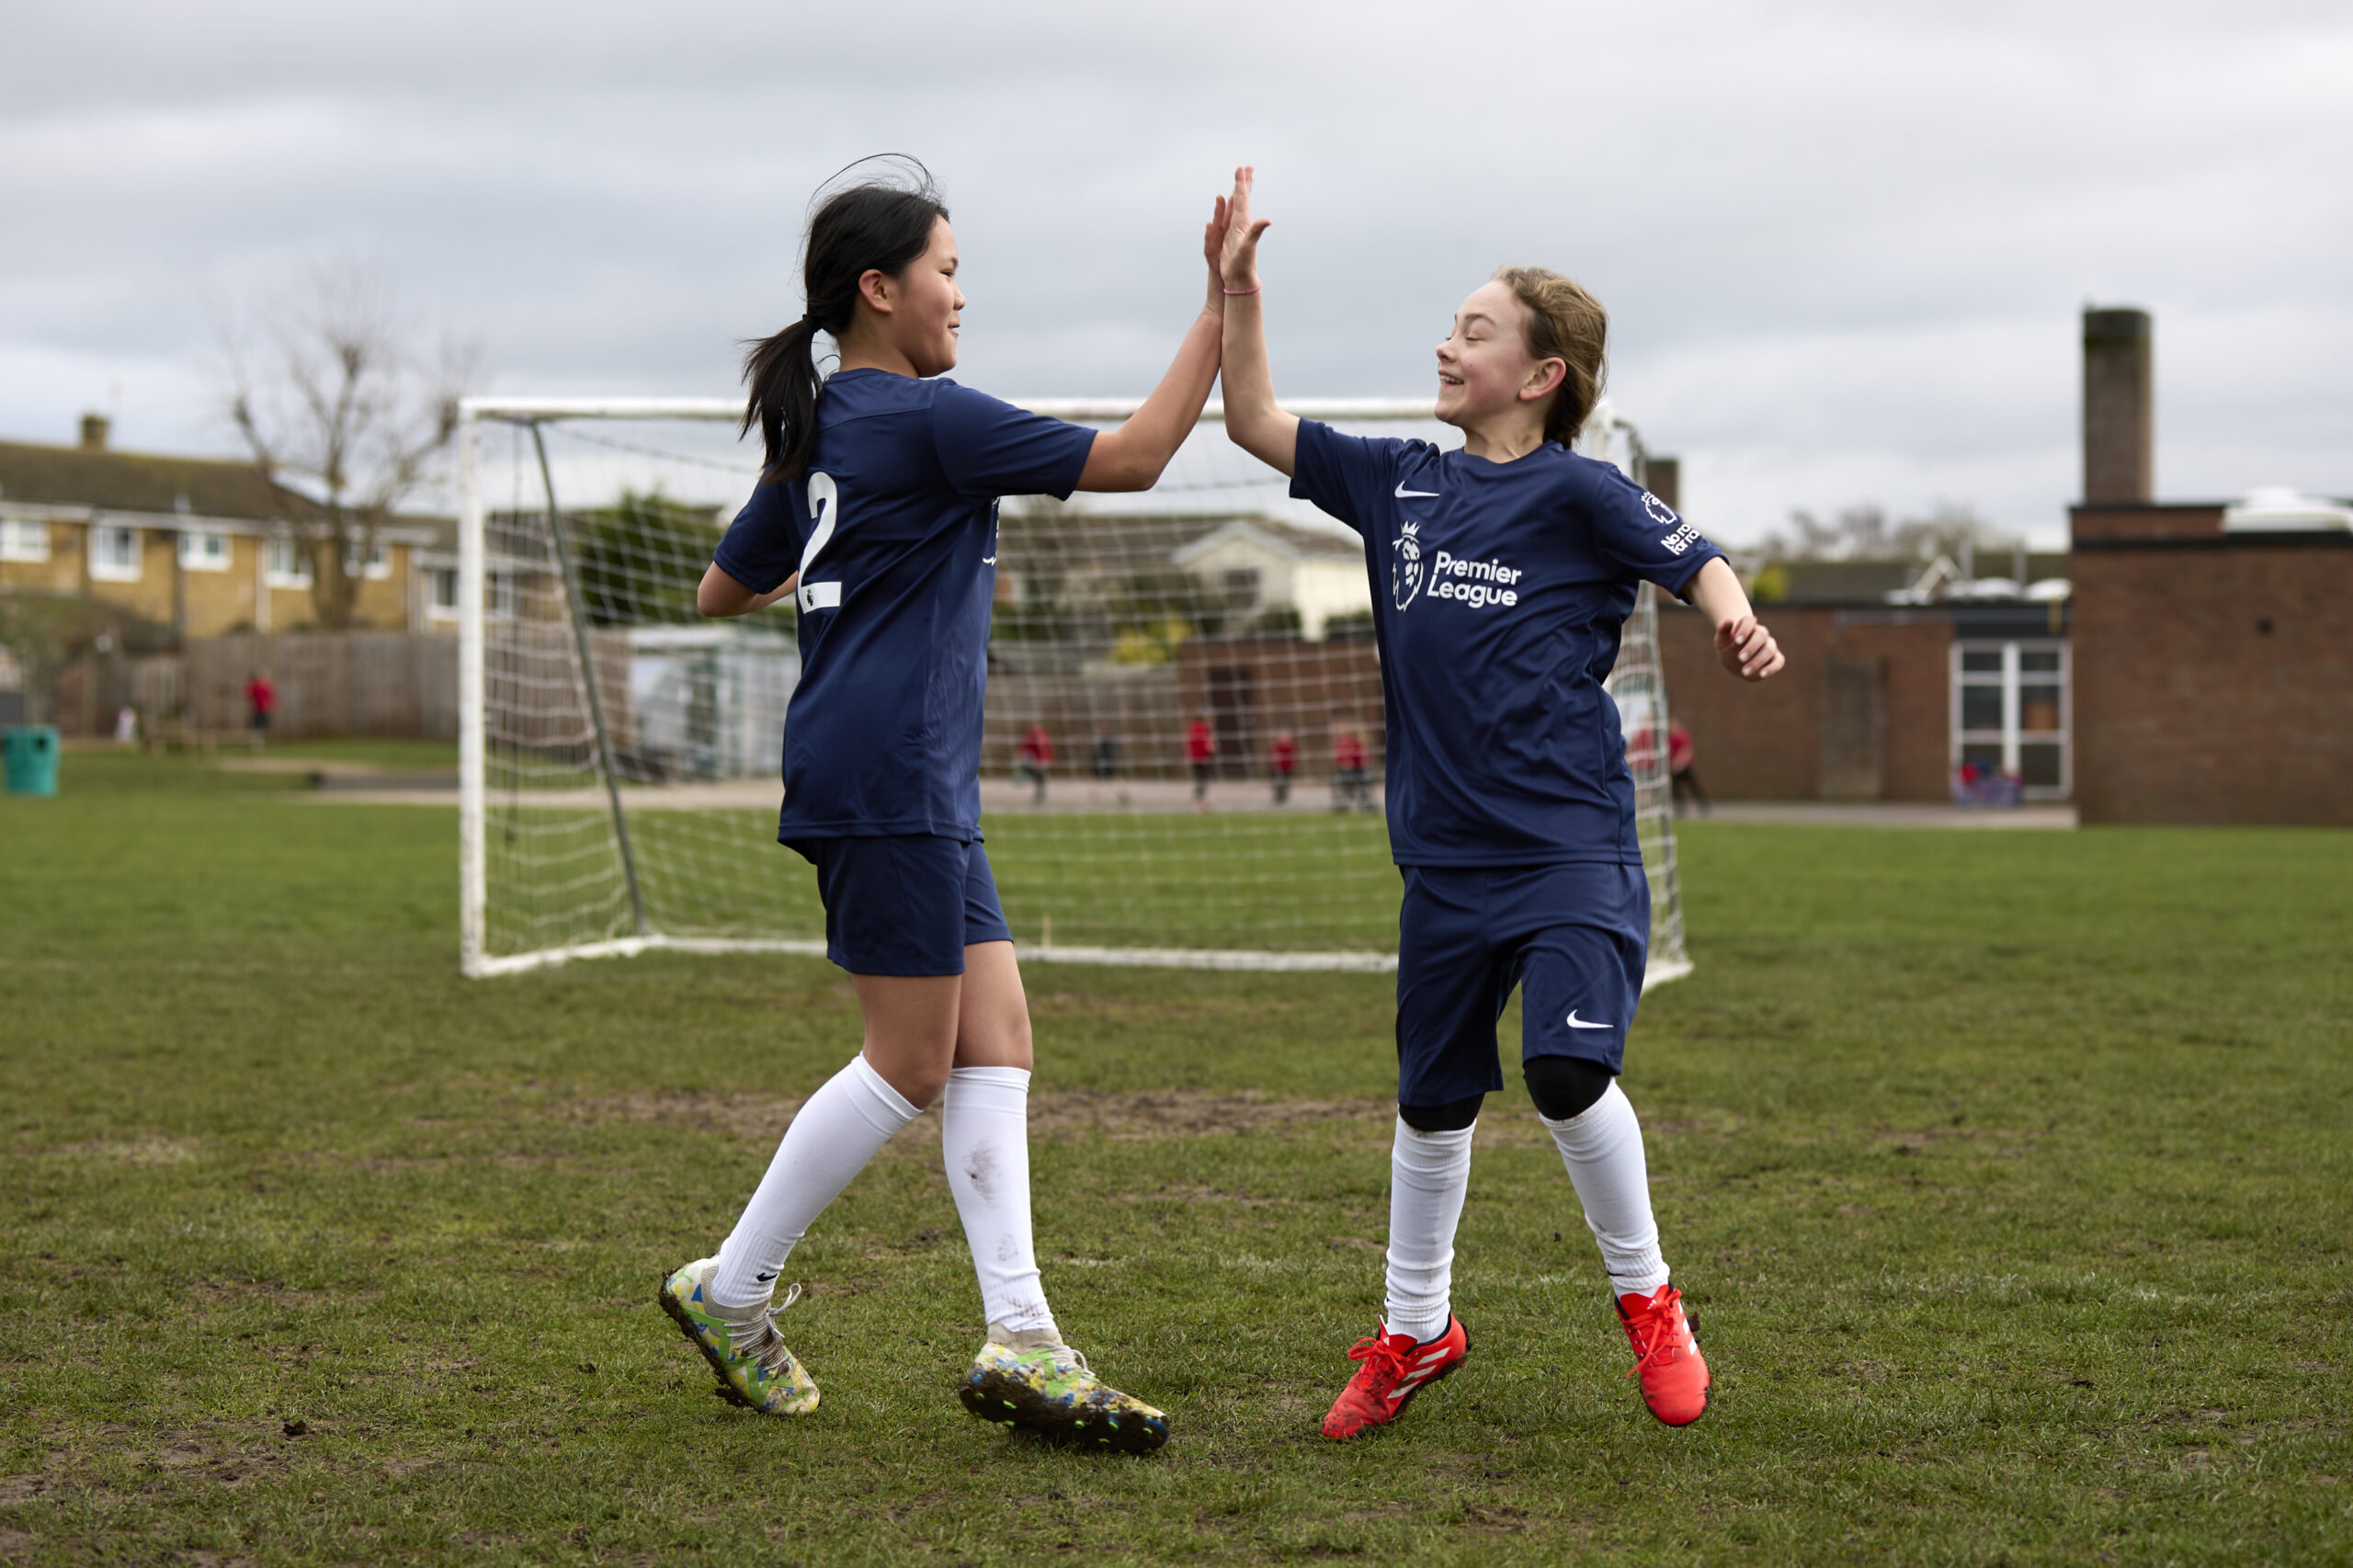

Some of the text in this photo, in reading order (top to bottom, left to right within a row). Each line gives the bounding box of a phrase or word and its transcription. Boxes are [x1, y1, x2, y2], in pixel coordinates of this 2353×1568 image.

[797, 472, 842, 614] 2
[1660, 523, 1691, 551] No ro
[1434, 551, 1522, 585] Premier
[1427, 574, 1518, 608] League
